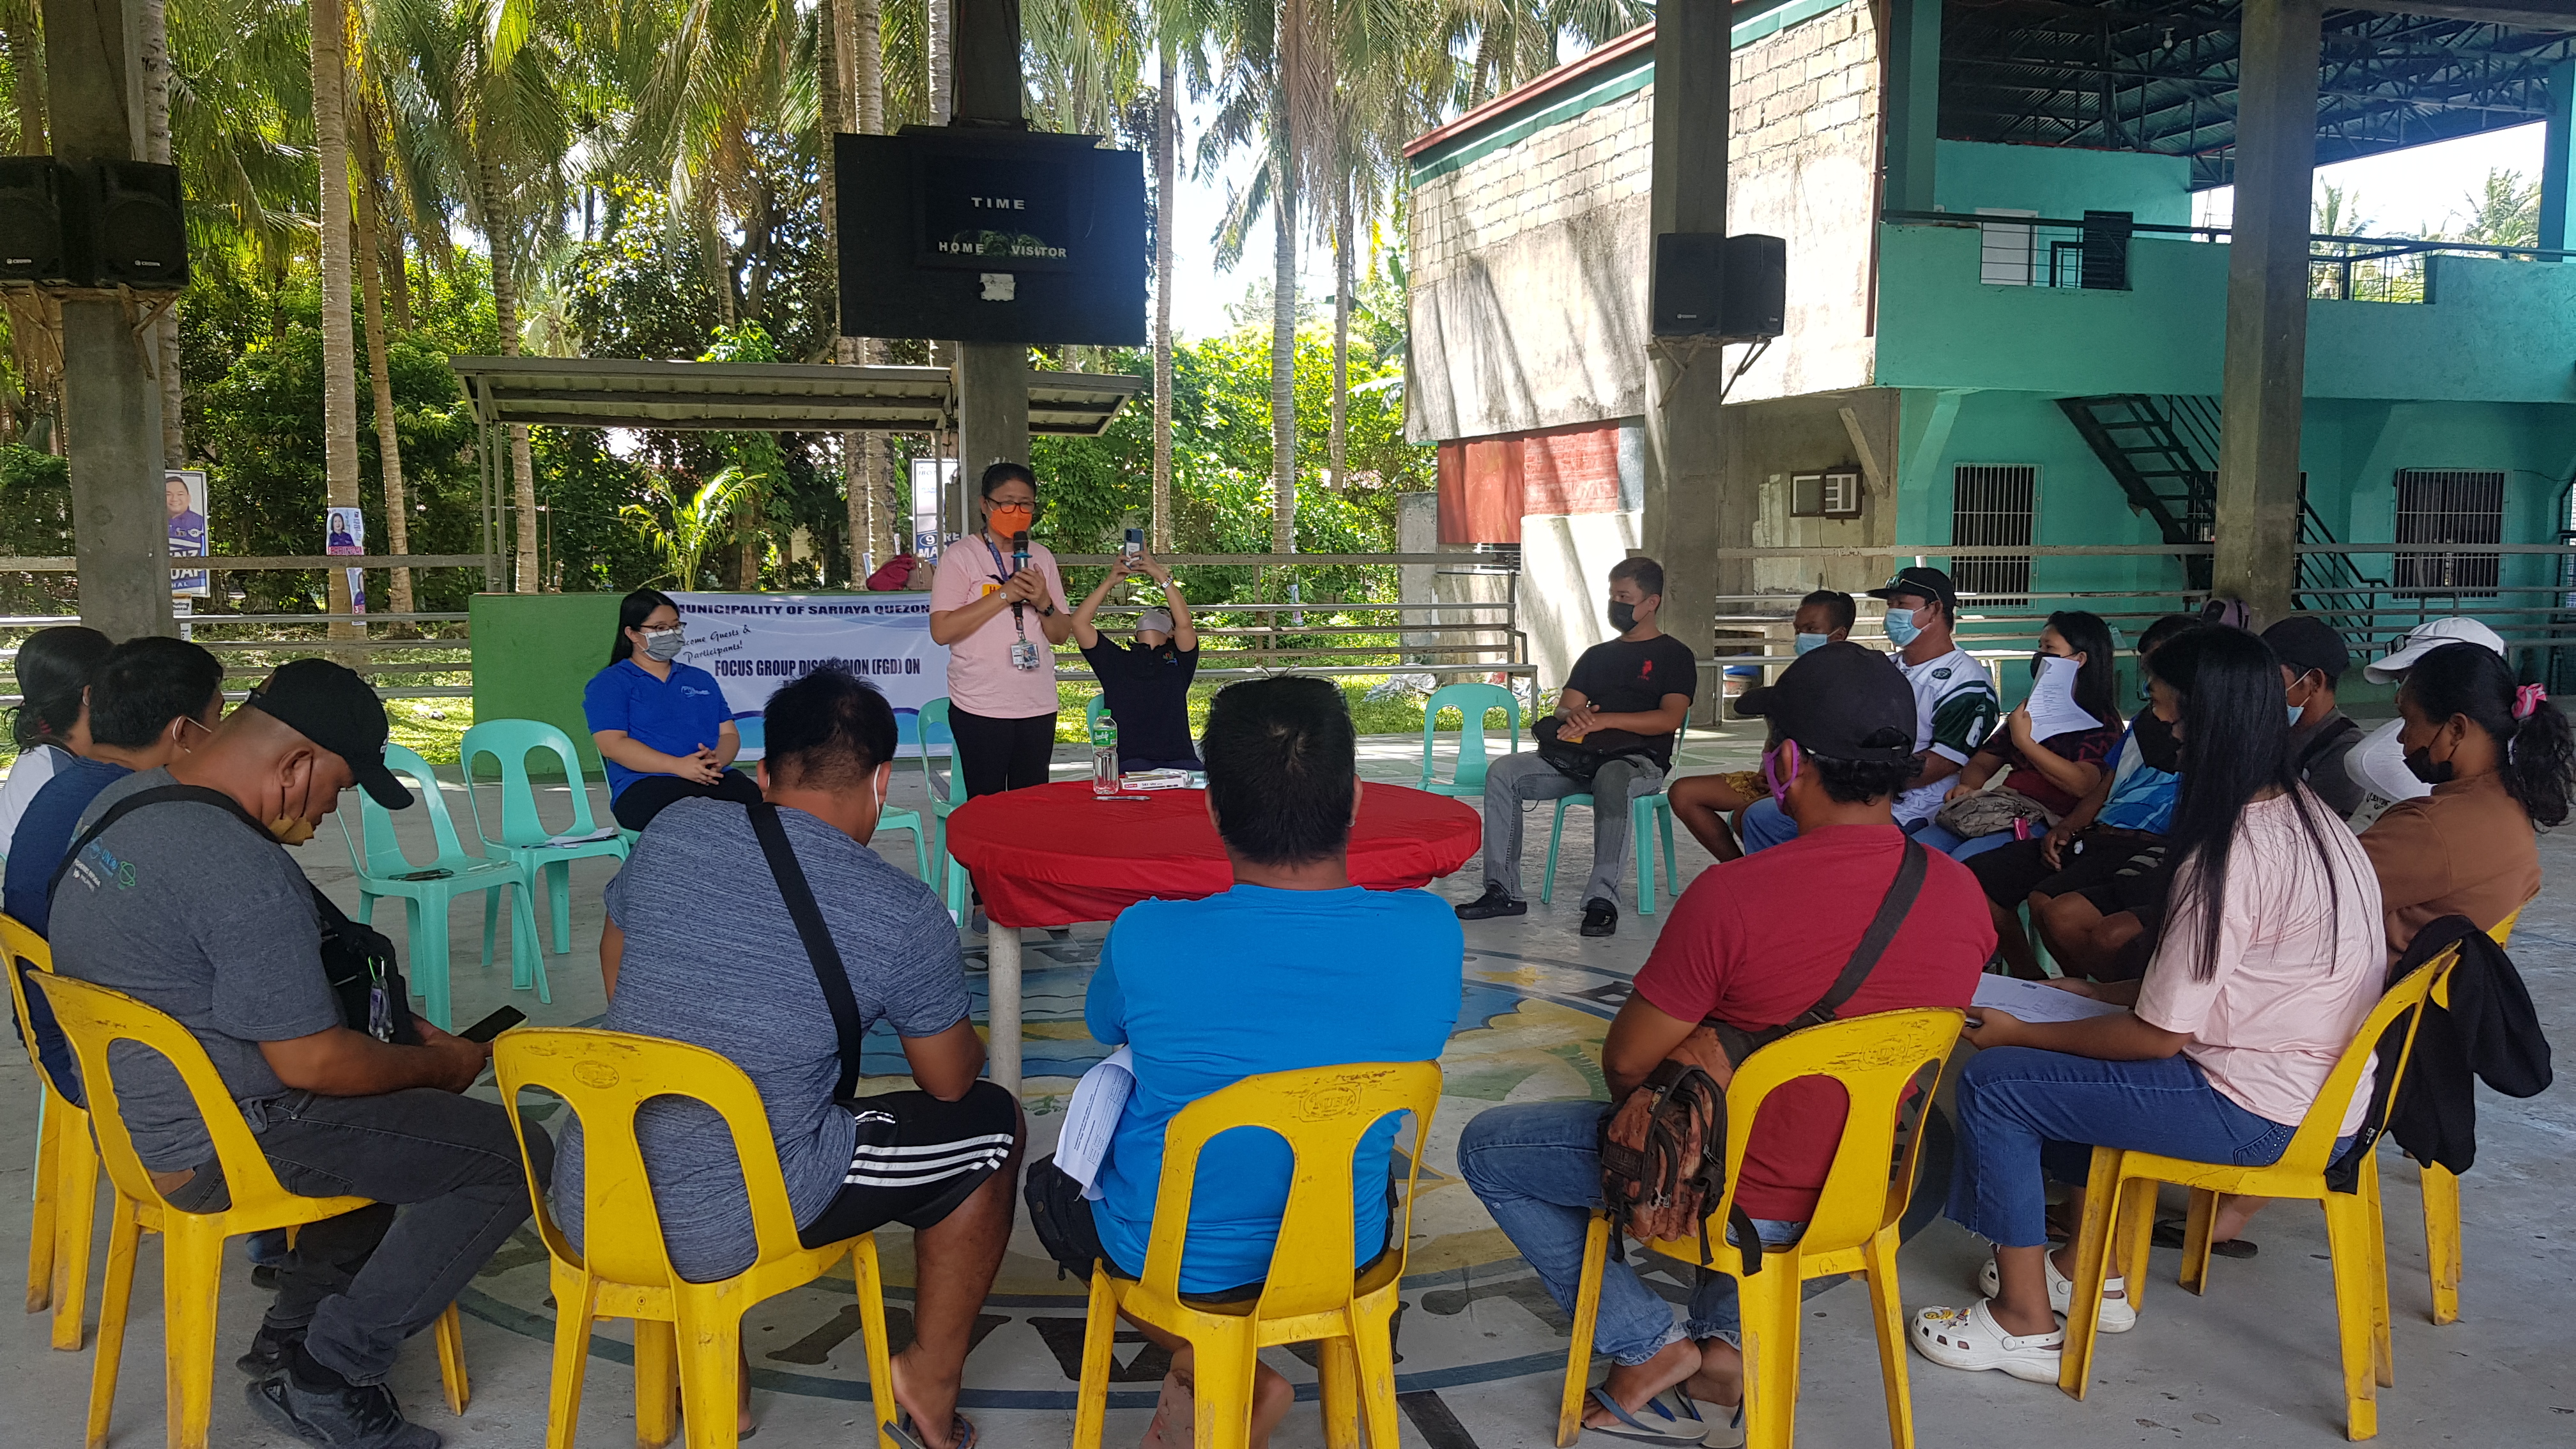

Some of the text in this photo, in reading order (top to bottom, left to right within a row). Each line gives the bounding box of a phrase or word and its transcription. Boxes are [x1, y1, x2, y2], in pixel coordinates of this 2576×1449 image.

[971, 197, 1025, 210] TIME
[939, 241, 1067, 257] HOME VISITOR
[926, 535, 935, 545] 9
[678, 604, 930, 615] MUNICIPALITY OF SARIAYA QUEZON
[710, 629, 739, 641] Guests
[743, 625, 751, 633] &
[683, 640, 743, 663] Participants!
[715, 659, 753, 677] FOCUS
[756, 659, 796, 677] GROUP
[872, 658, 902, 675] (FGD)
[905, 658, 921, 675] ON
